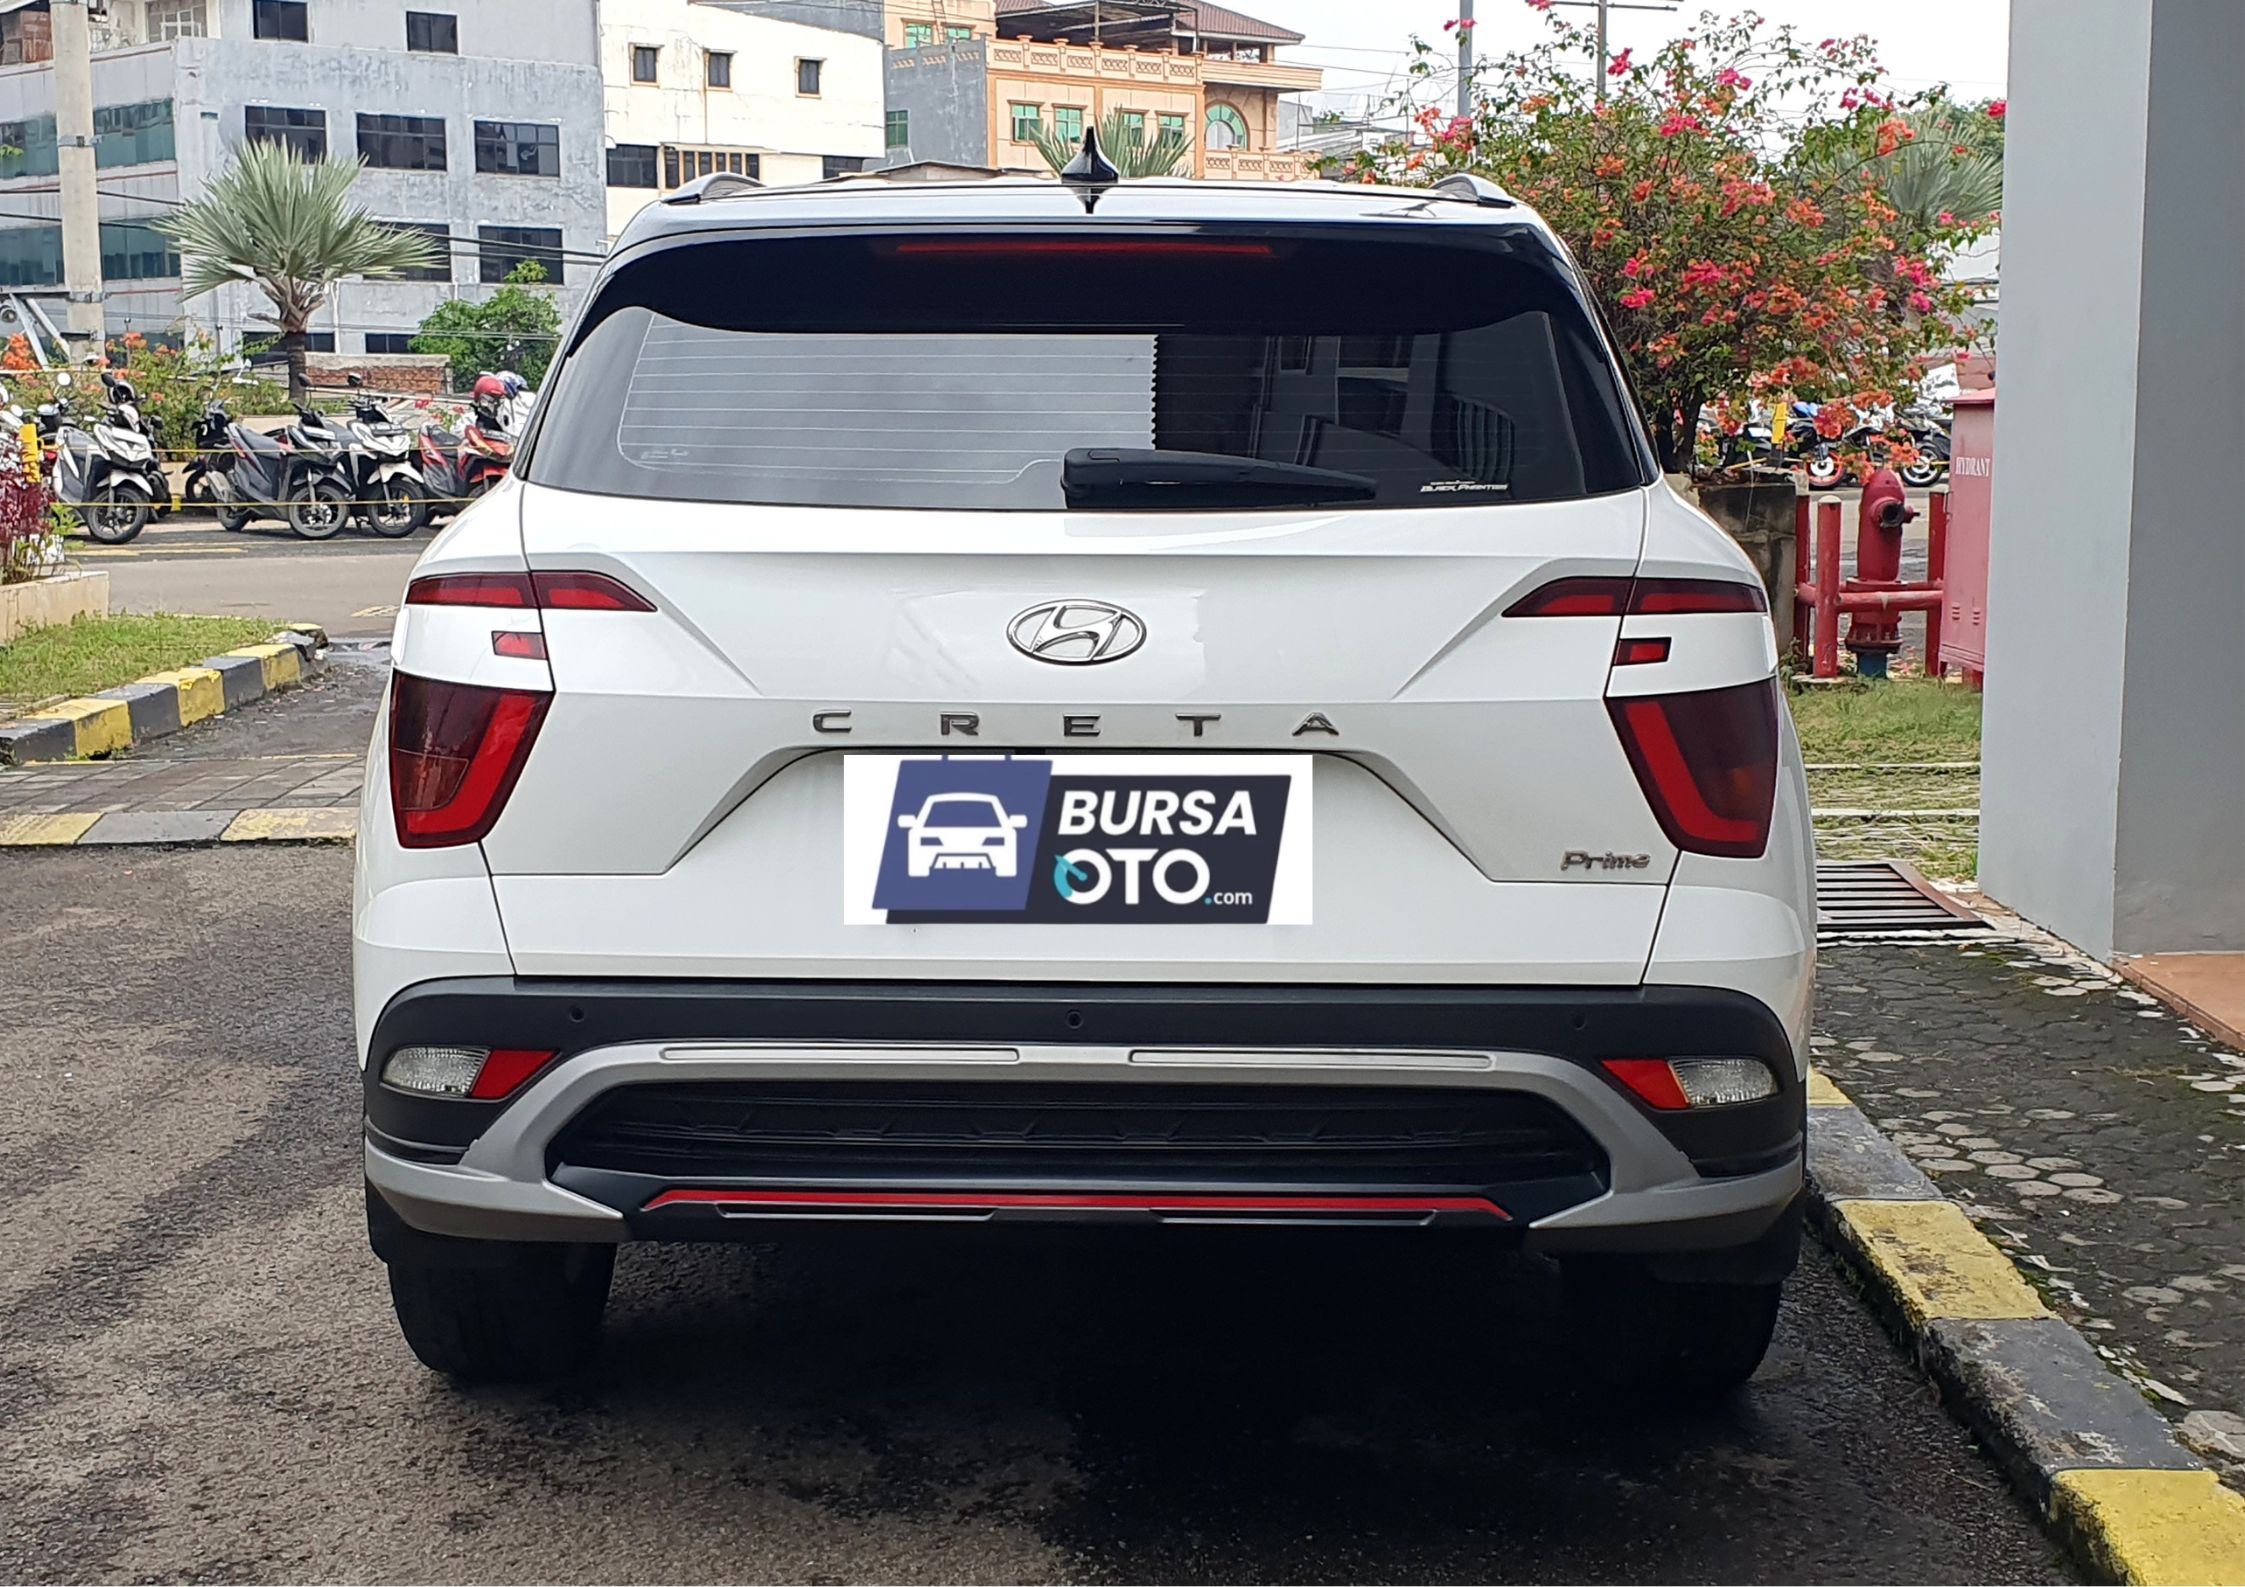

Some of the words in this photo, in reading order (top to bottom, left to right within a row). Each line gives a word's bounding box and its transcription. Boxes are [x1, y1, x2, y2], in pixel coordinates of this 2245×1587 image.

[1955, 457, 1990, 477] HYDRANT
[811, 708, 1340, 738] CRETA
[1561, 850, 1651, 871] Prime
